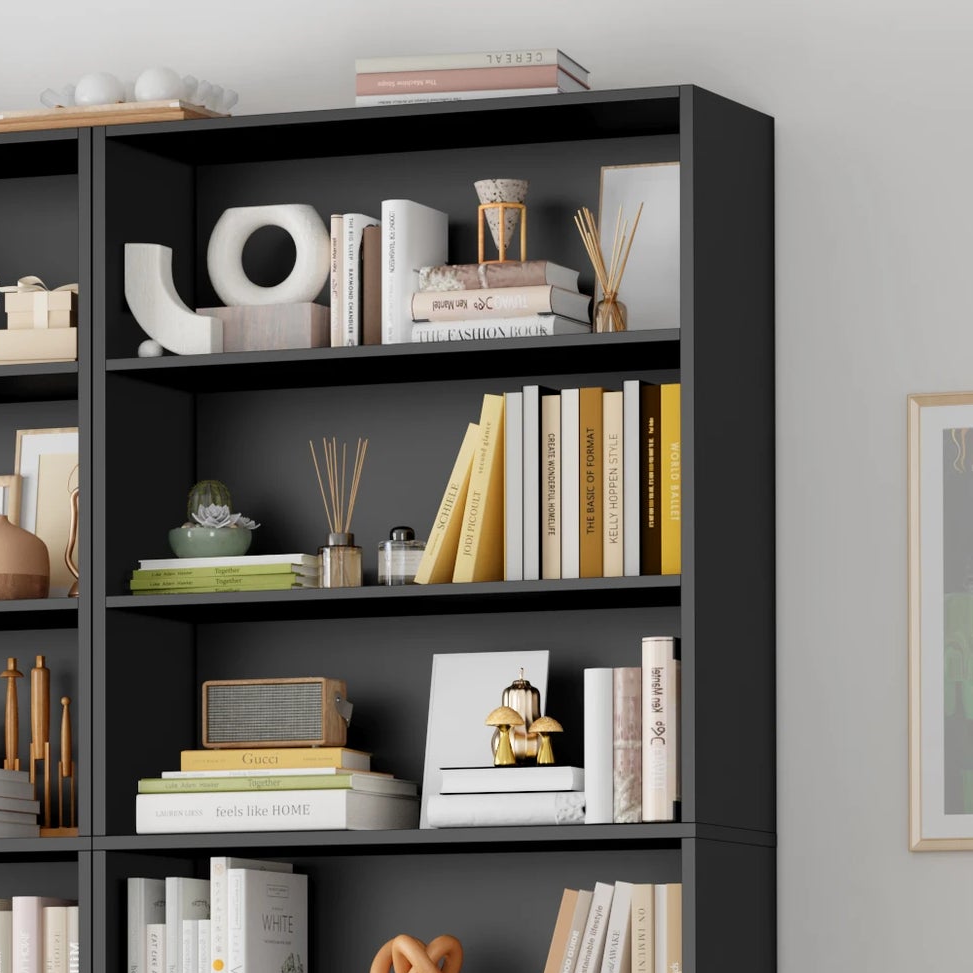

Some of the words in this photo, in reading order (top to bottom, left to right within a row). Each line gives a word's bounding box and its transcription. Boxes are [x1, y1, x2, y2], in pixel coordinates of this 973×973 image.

[486, 52, 543, 64] CEREAL
[431, 299, 455, 312] Mantel
[455, 299, 468, 311] Ken
[586, 427, 596, 468] FORMAT
[608, 432, 618, 465] STYLE
[586, 470, 596, 484] OF
[608, 467, 618, 510] HOPPEN
[436, 482, 461, 532] SCHIELE
[586, 486, 596, 515] BASIC
[467, 490, 483, 534] PICOULT
[586, 516, 596, 536] THE
[608, 512, 618, 545] KELLY
[462, 533, 475, 558] JODI
[215, 577, 243, 585] Together
[241, 752, 279, 765] Gucci
[247, 778, 282, 789] Together
[215, 804, 244, 818] feels
[246, 804, 269, 817] like
[272, 803, 311, 817] HOME
[261, 912, 294, 934] WHITE
[590, 904, 604, 936] lifestyle
[637, 907, 646, 923] ON
[567, 930, 580, 958] GUIDE
